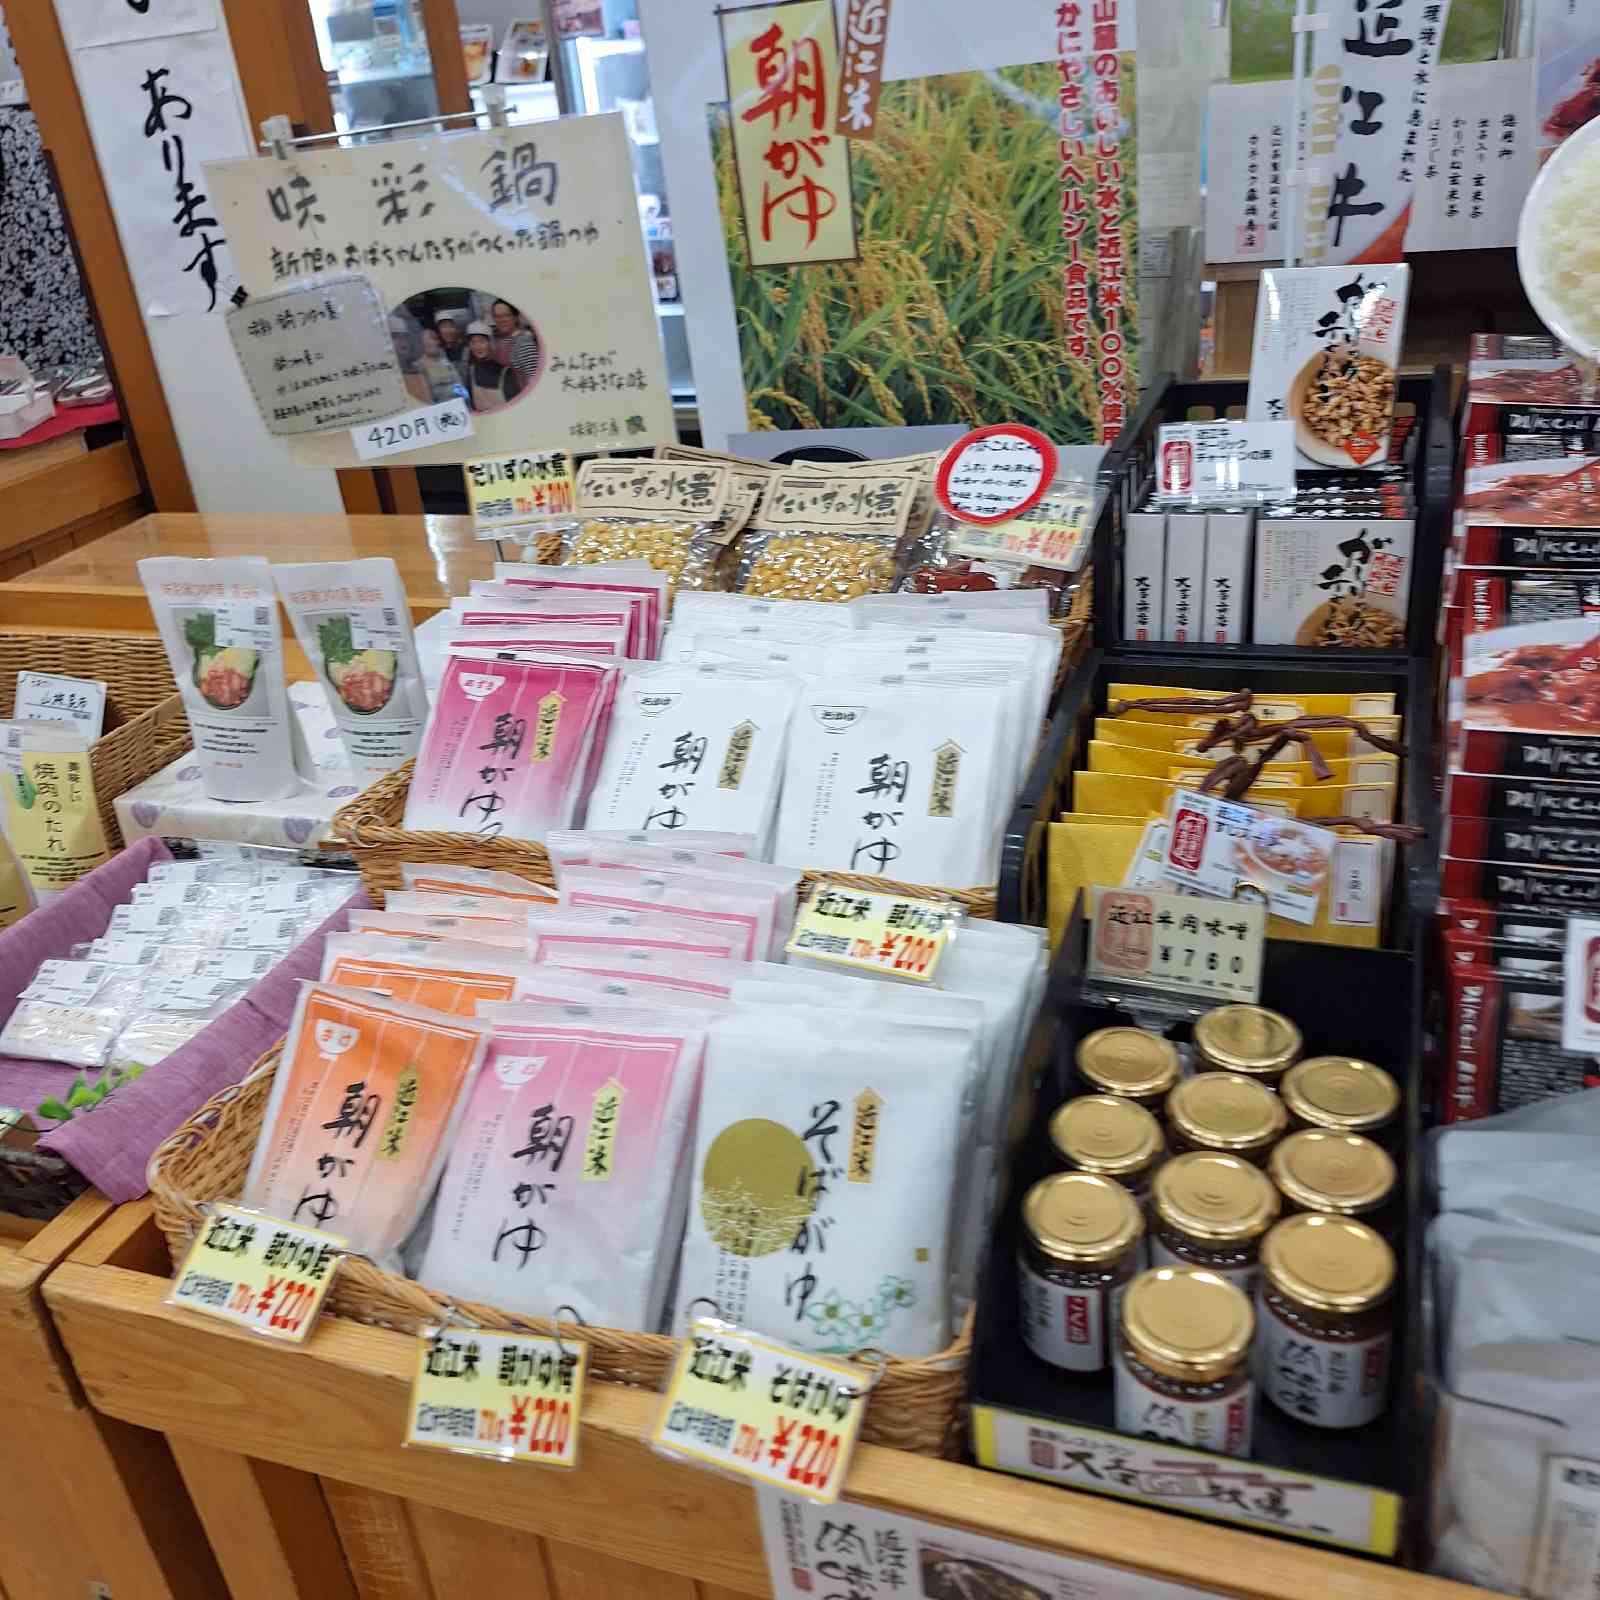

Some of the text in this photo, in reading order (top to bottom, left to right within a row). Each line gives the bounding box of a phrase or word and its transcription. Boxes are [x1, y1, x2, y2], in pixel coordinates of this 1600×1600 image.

[140, 68, 227, 313] あります
[742, 22, 837, 250] 朝がゆ
[459, 713, 525, 820] 朝がゆ
[646, 731, 709, 831] 朝がゆ
[850, 753, 910, 874] 朝がゆ
[1159, 944, 1244, 974] ¥760
[292, 1082, 380, 1227] 朝がゆ
[491, 1102, 574, 1270] 朝がゆ
[784, 1100, 844, 1321] そばがゆ
[508, 1395, 571, 1455] ¥220
[768, 1415, 840, 1489] ¥220
